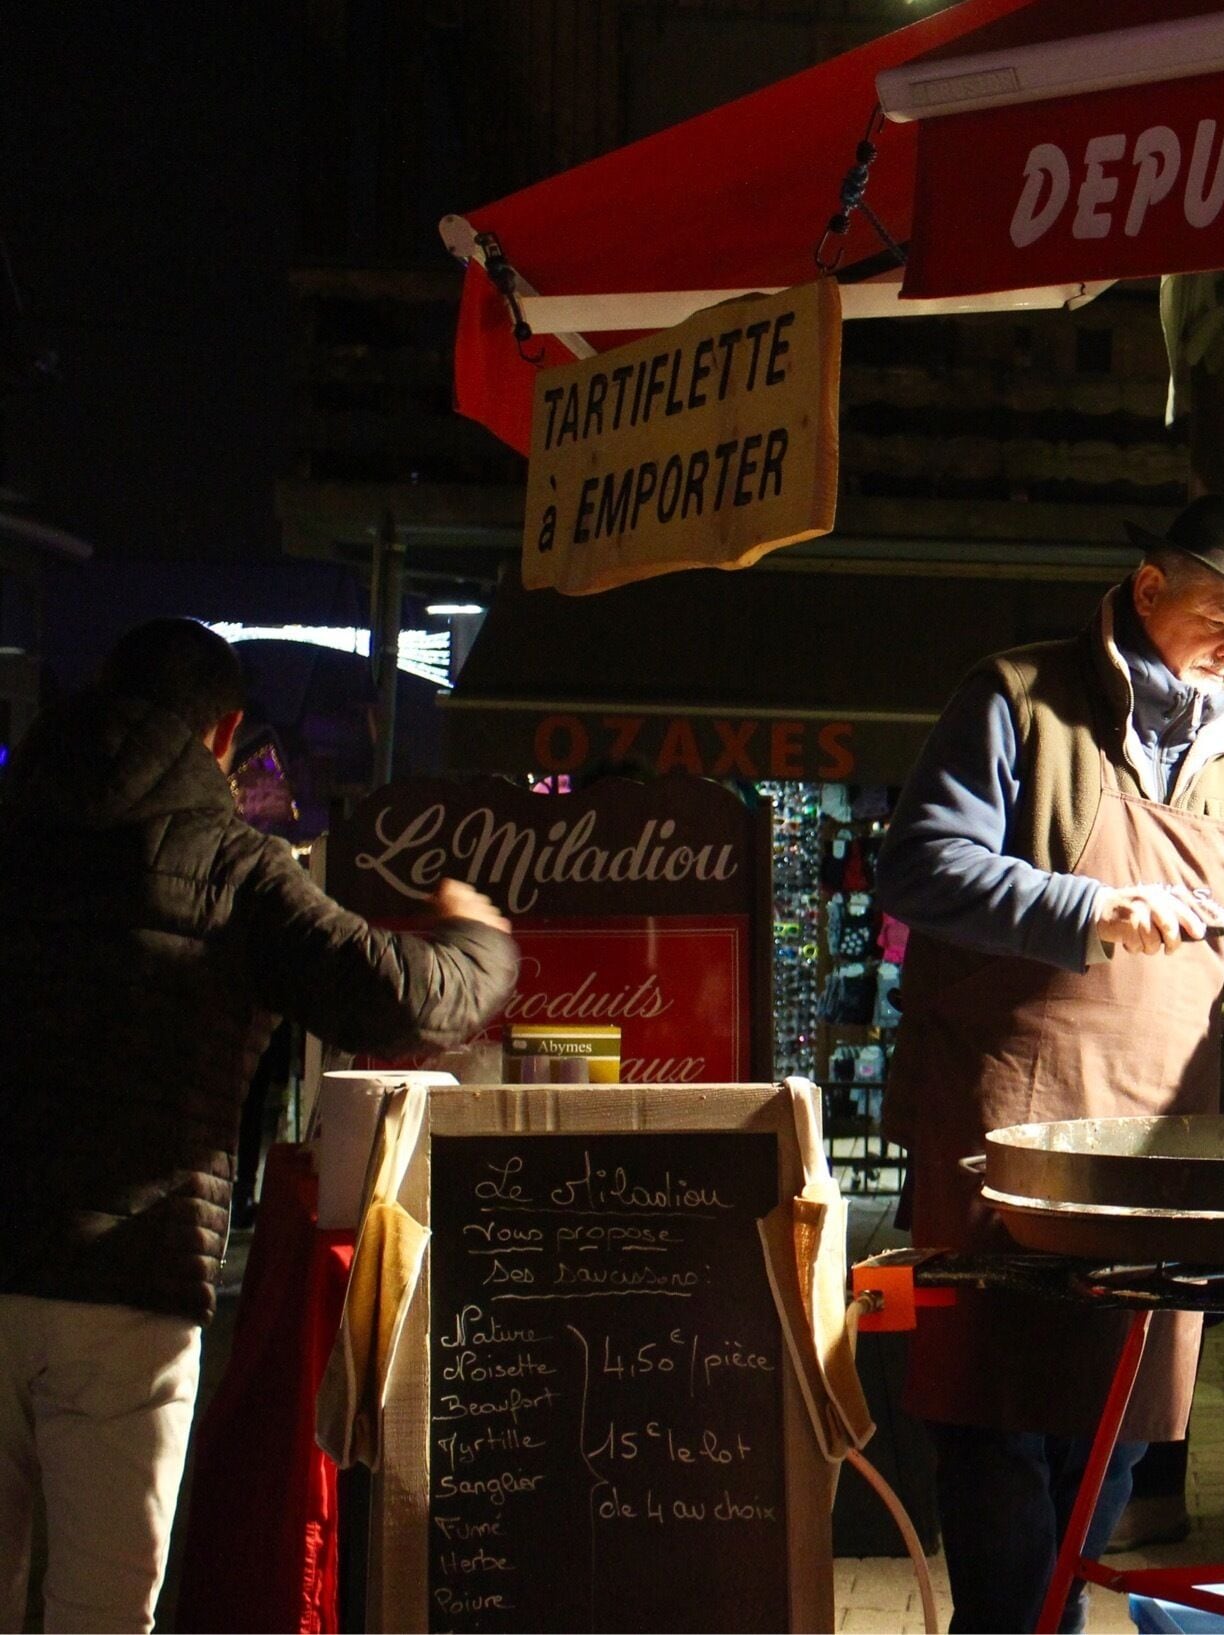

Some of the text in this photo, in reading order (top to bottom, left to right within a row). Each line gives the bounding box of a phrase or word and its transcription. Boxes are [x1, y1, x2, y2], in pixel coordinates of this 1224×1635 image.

[543, 311, 796, 450] TARTIFLETTE
[537, 427, 790, 554] à EMPORTER
[355, 802, 739, 914] Le Miladiou
[537, 1040, 593, 1056] Abymes
[474, 1156, 533, 1205] Le
[555, 1225, 684, 1254] propose
[440, 1305, 554, 1349] Nature
[442, 1351, 559, 1382] Noisette
[431, 1387, 560, 1423] Beaufort
[434, 1469, 546, 1506] Sanglier
[599, 1486, 777, 1524] de 4 au choix
[434, 1513, 504, 1541] Fumé
[440, 1549, 517, 1575] Herbe
[433, 1587, 517, 1615] Poivre
